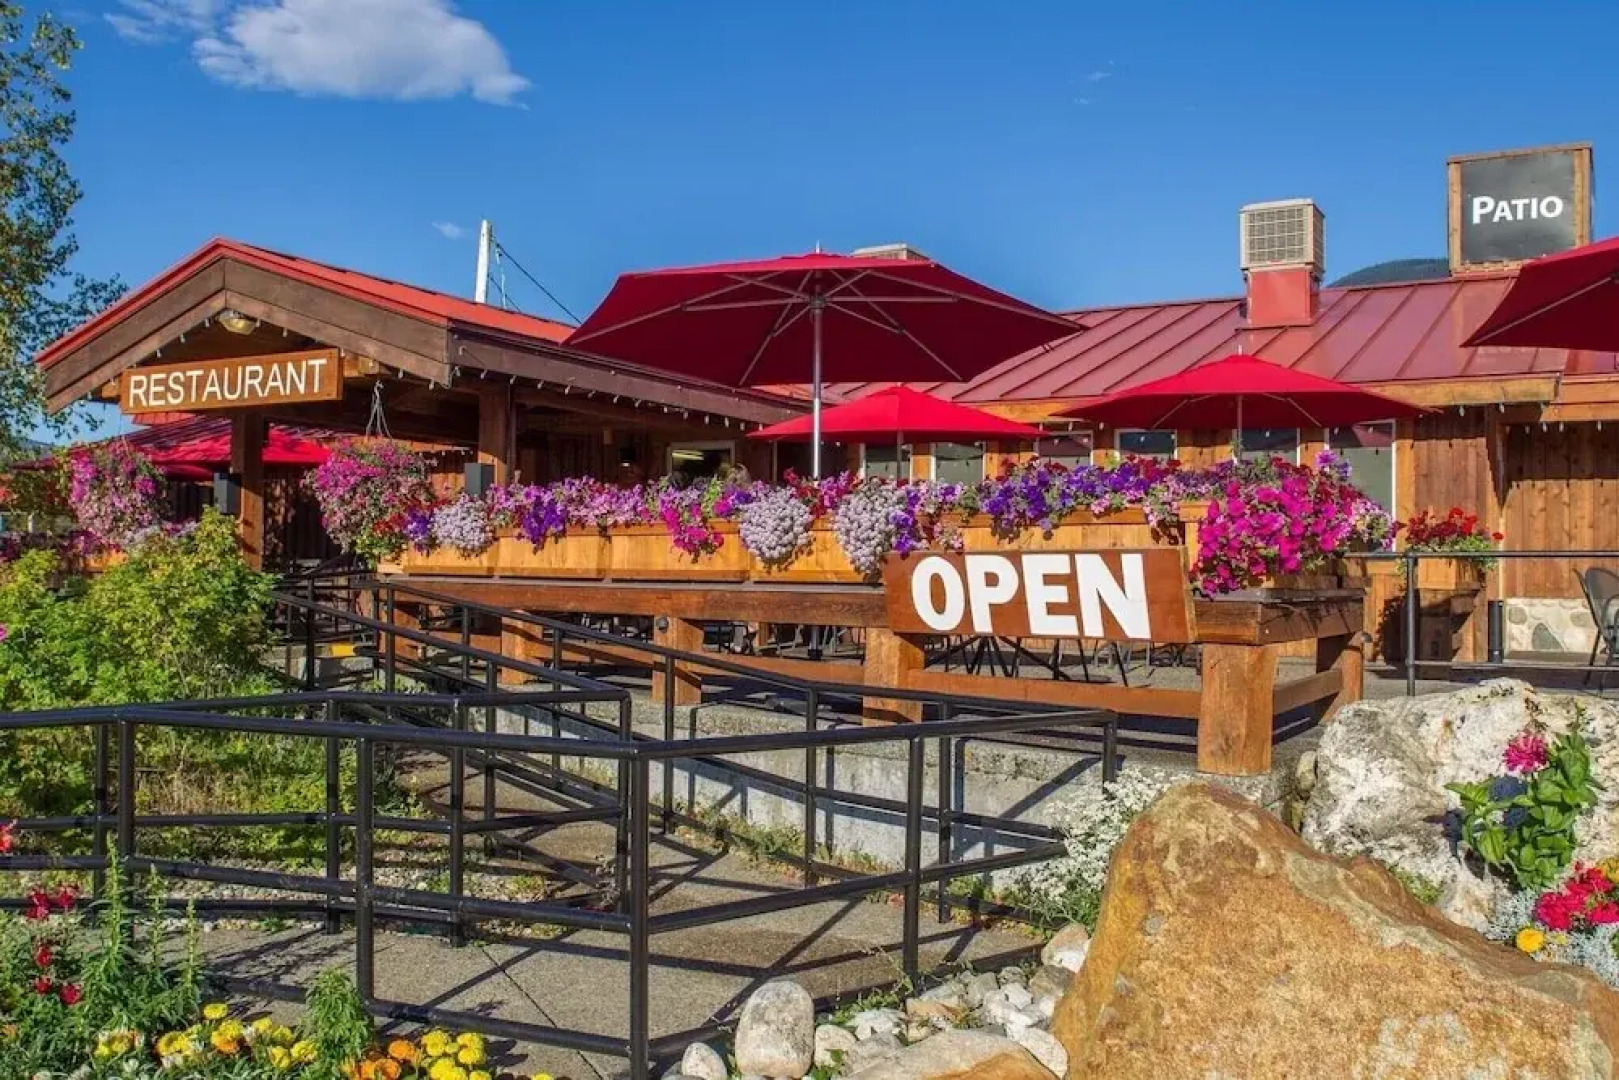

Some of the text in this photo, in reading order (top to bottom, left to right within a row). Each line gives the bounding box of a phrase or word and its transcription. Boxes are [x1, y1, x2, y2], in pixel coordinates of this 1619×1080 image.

[1472, 195, 1564, 224] PATIO
[129, 358, 327, 407] RESTAURANT
[911, 553, 1151, 638] OPEN
